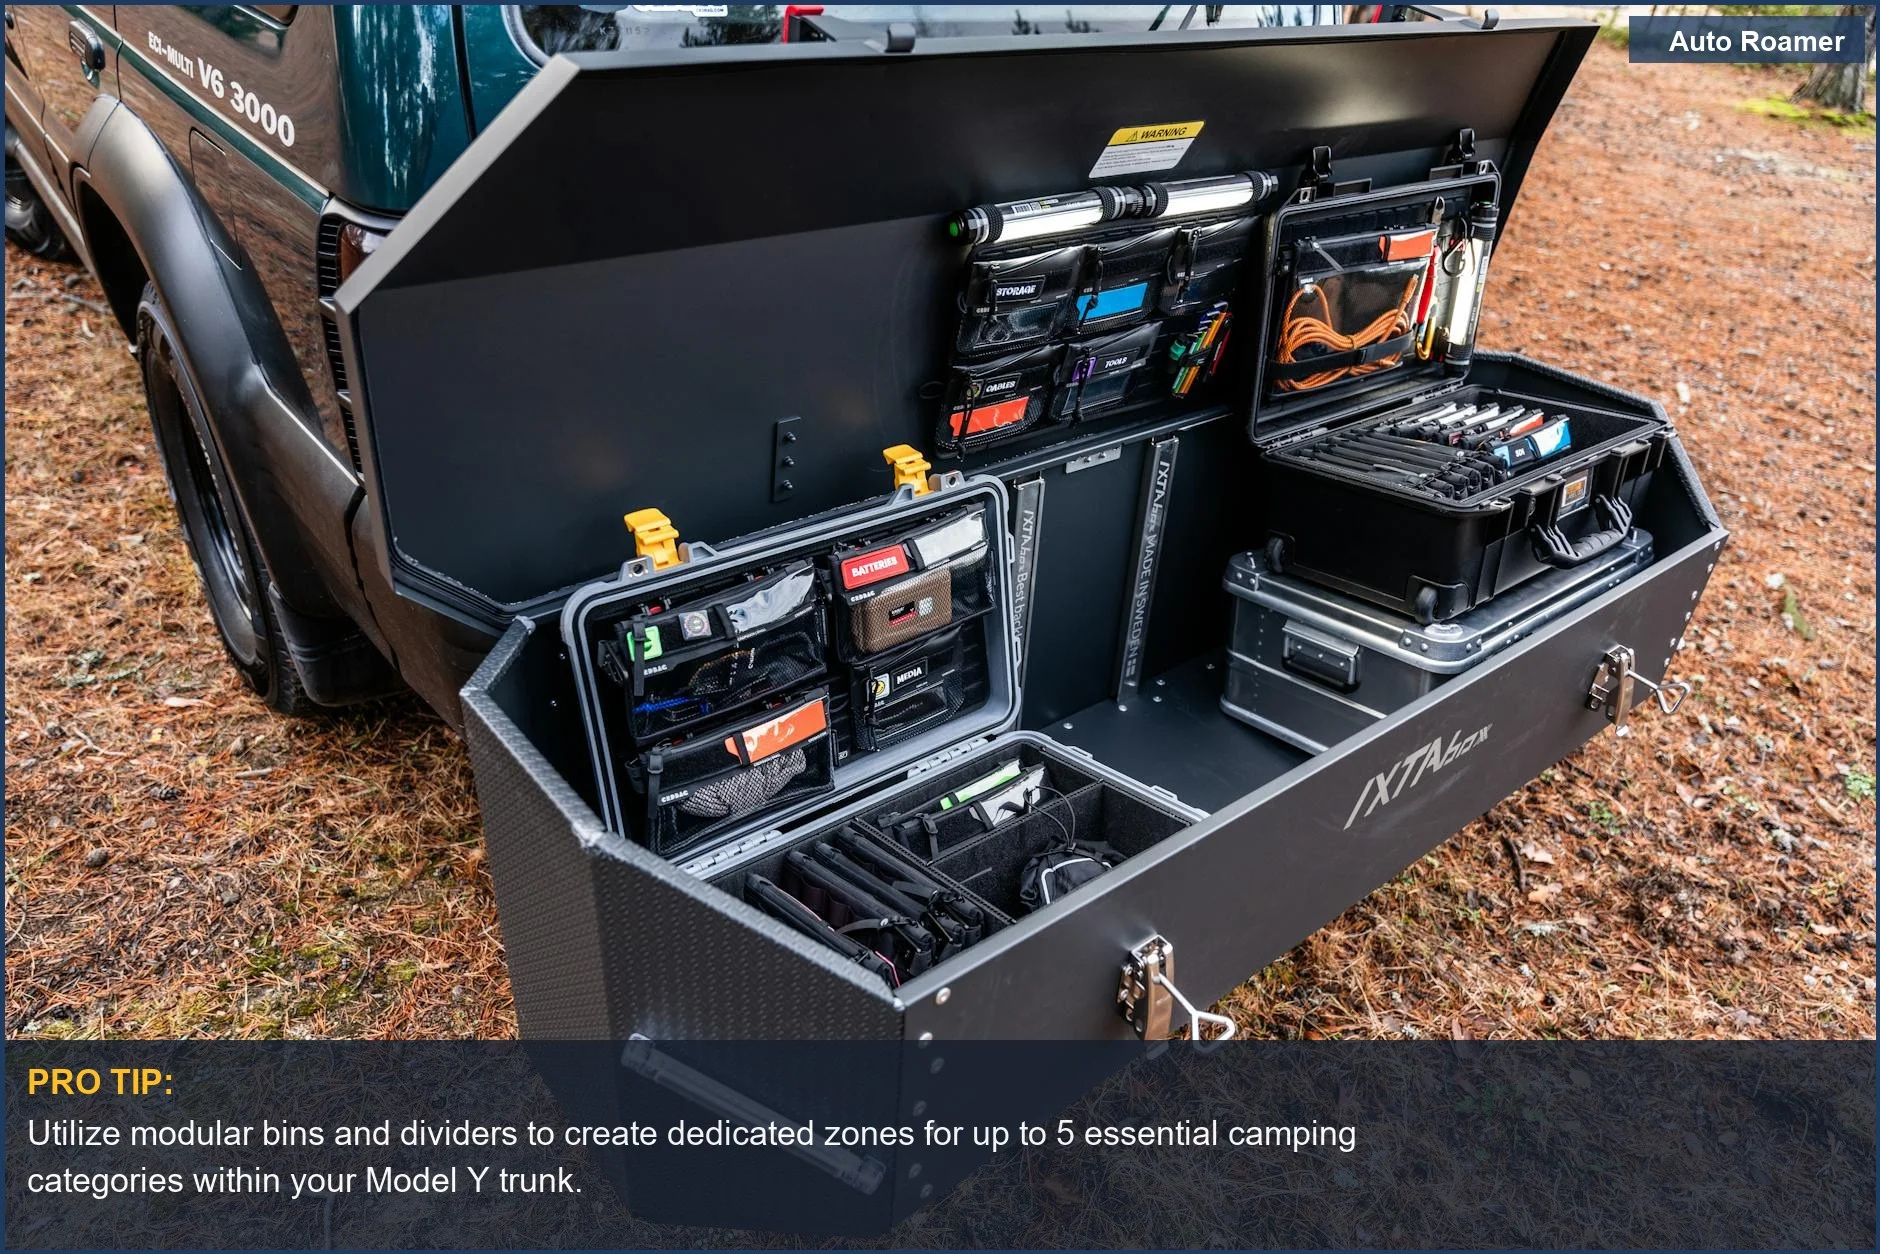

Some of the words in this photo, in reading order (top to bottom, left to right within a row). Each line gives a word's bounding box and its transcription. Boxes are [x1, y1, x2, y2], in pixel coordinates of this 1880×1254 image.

[148, 31, 194, 78] ECI-MULTI
[198, 57, 224, 98] V6
[230, 81, 295, 147] 3000
[1141, 127, 1187, 140] WARNING
[996, 285, 1036, 296] STORAGE
[1105, 357, 1127, 368] TOOLS
[985, 381, 1016, 392] CABLES
[1140, 533, 1158, 577] MADE
[851, 556, 898, 577] BATTERIES
[1016, 571, 1028, 602] Best
[1137, 579, 1149, 600] IN
[1128, 598, 1147, 661] SWEDEN
[896, 667, 923, 685] MEDIA
